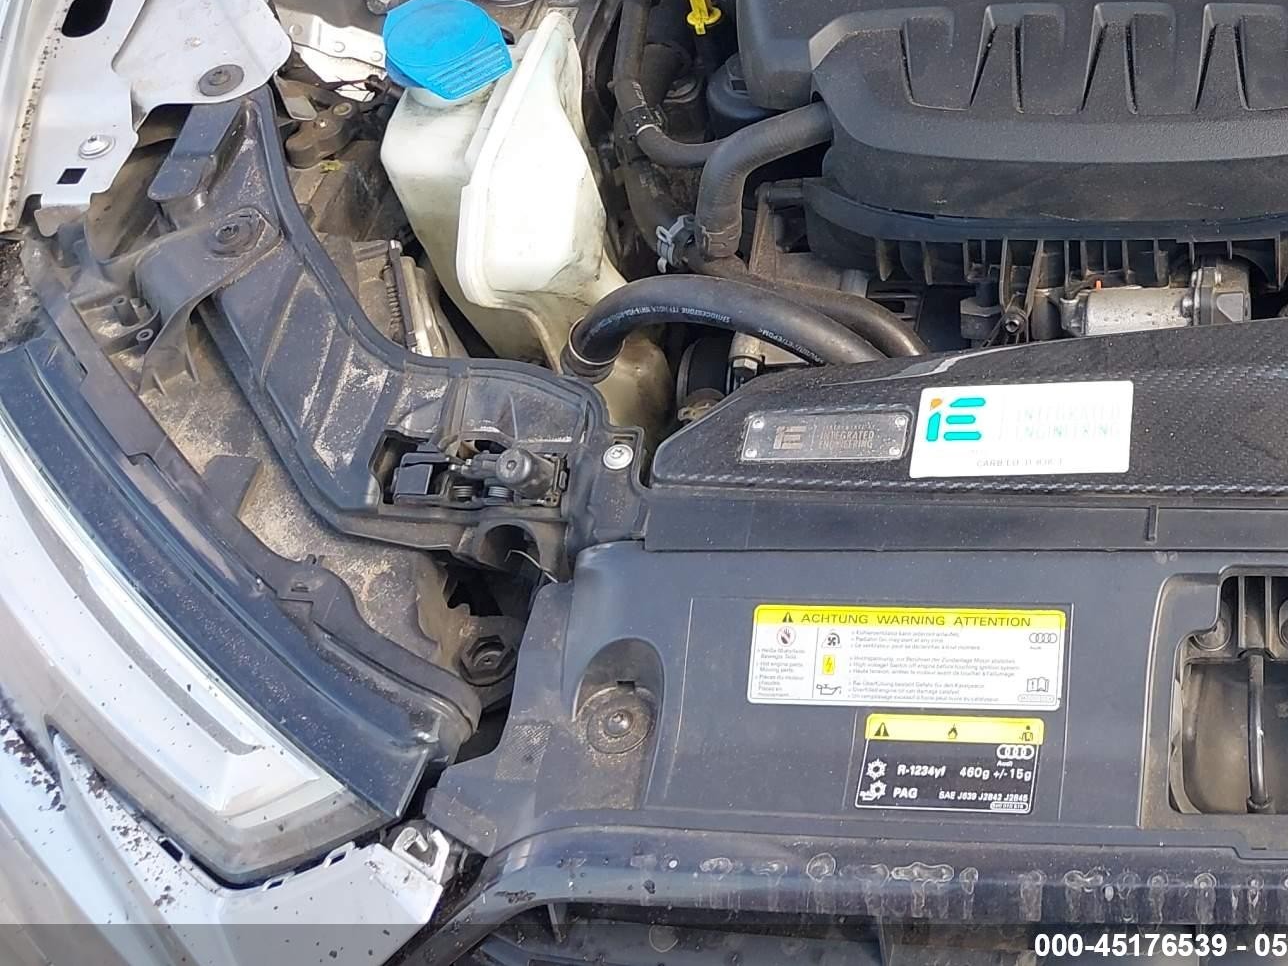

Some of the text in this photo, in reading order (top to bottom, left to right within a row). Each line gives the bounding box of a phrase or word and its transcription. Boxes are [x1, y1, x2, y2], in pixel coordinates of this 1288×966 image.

[800, 613, 1031, 627] ACHTUNG WARNING ATTENTION
[897, 764, 946, 778] R-1234yf
[959, 766, 989, 780] 460g
[893, 787, 918, 799] PAG
[939, 791, 956, 800] SAE
